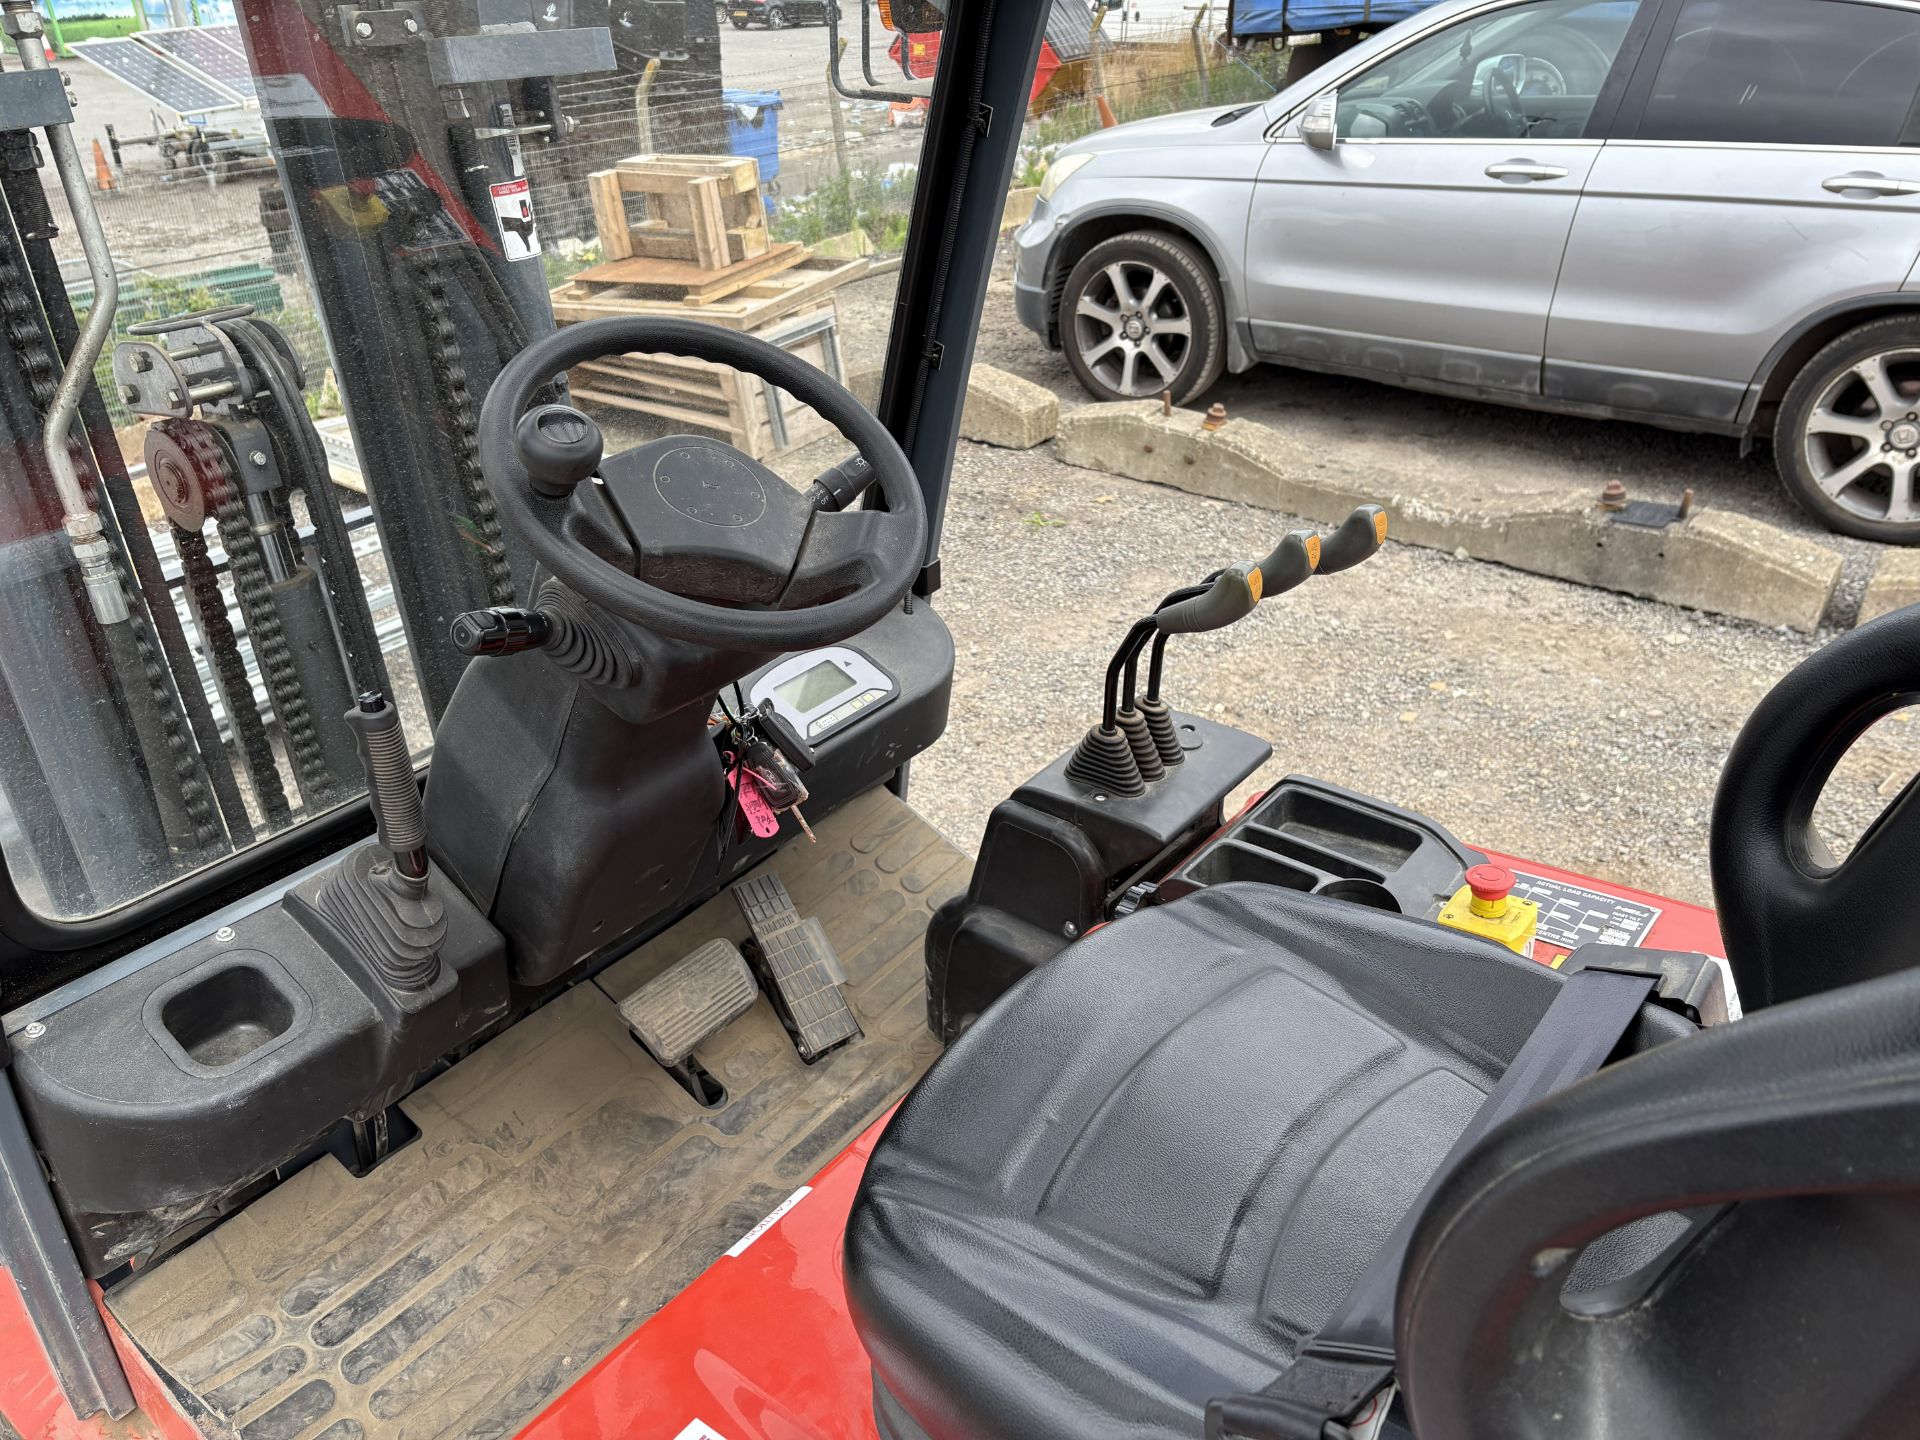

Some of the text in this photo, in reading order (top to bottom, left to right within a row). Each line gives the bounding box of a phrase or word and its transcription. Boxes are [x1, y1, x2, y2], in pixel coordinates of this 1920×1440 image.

[1536, 880, 1561, 890] ACTUAL
[1562, 887, 1581, 896] LOAD
[1582, 892, 1616, 904] CAPACITY
[744, 1199, 792, 1241] CAUTION
